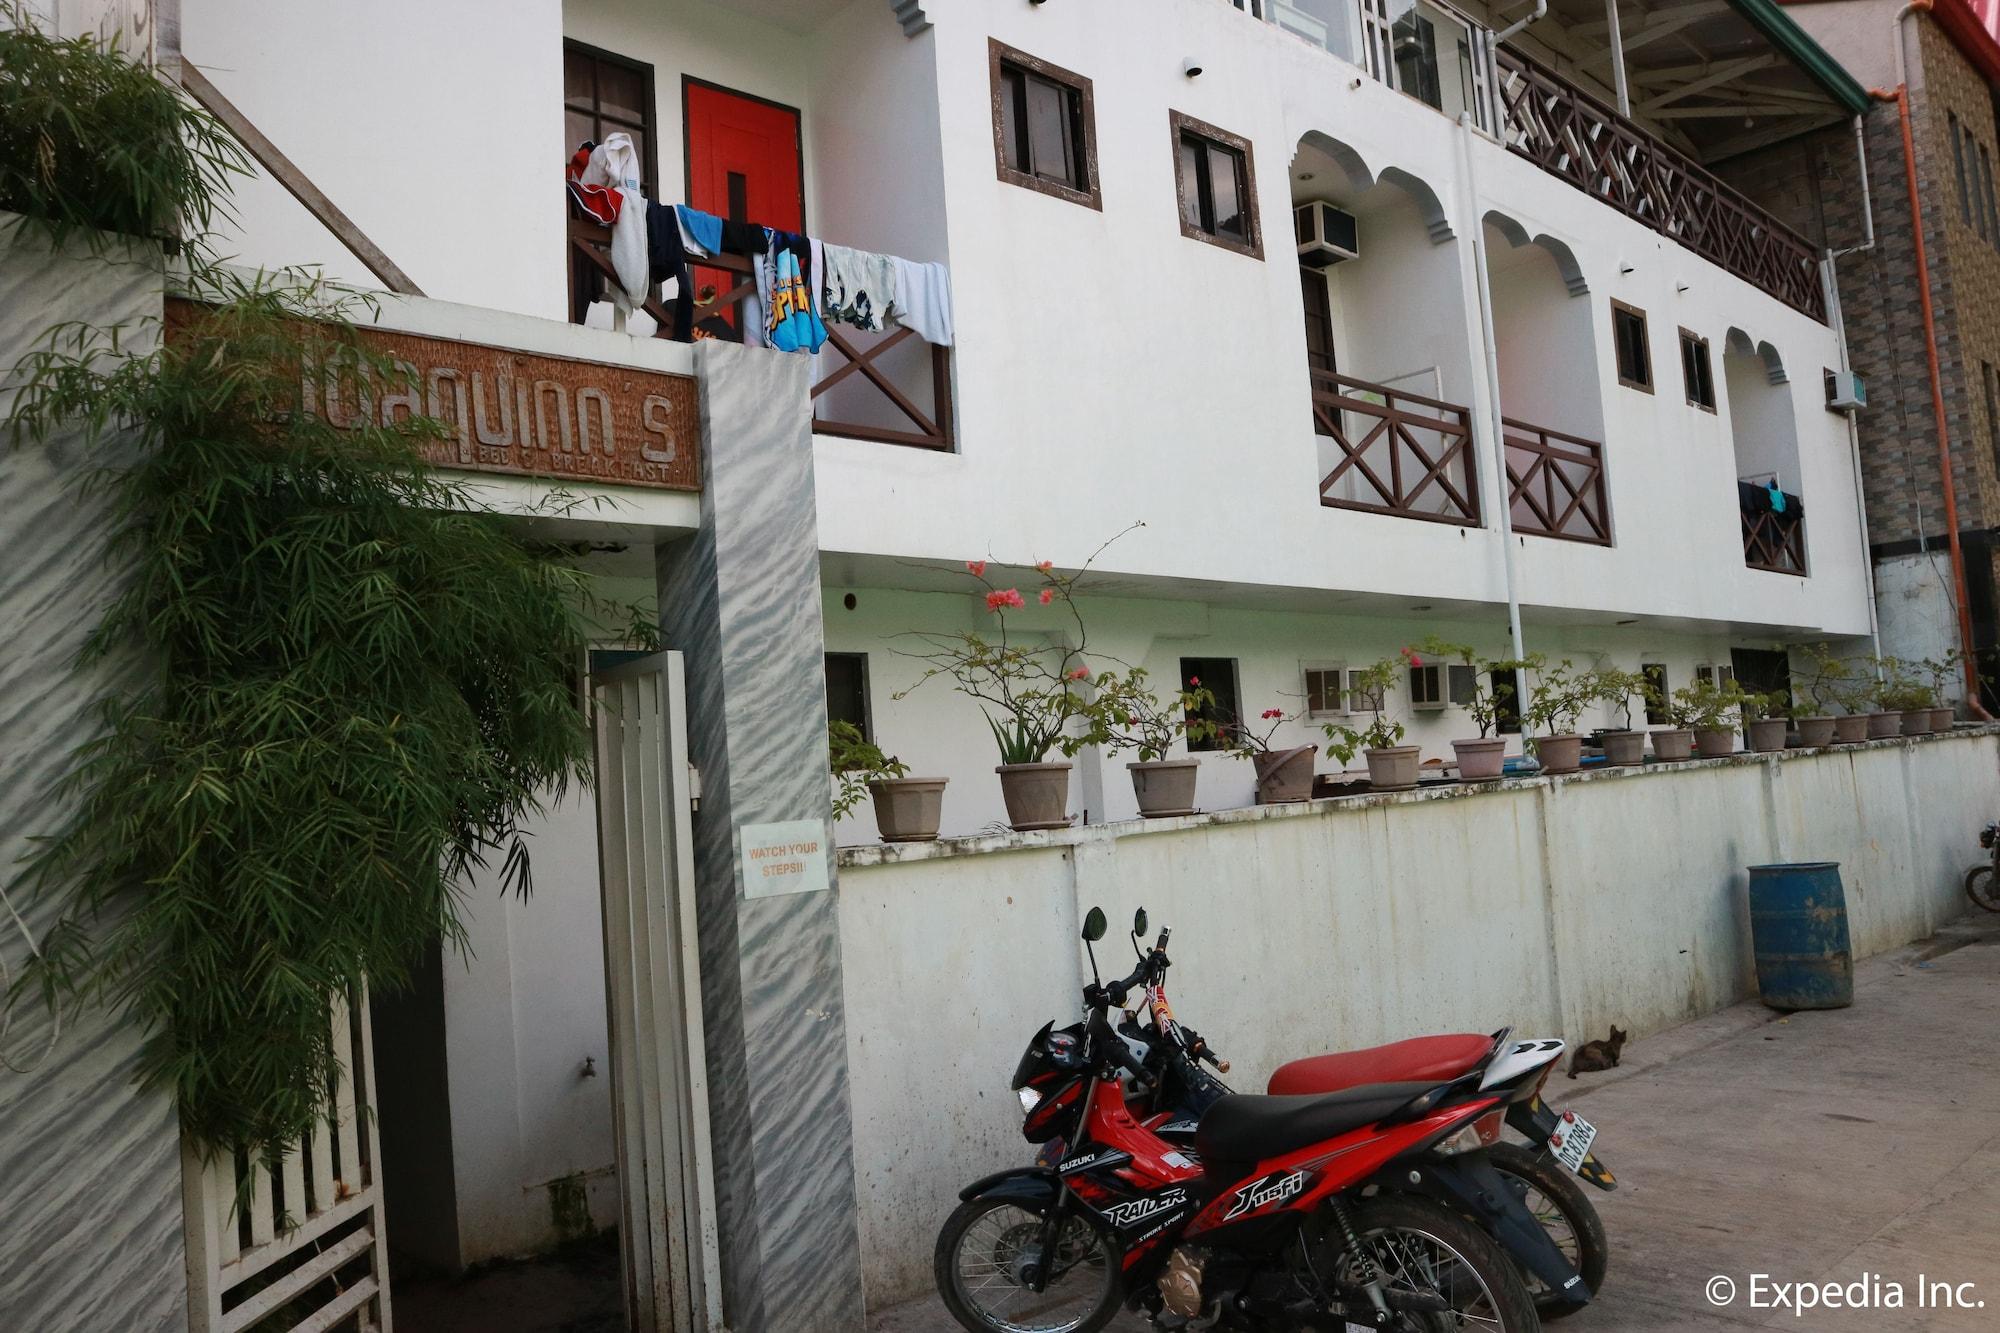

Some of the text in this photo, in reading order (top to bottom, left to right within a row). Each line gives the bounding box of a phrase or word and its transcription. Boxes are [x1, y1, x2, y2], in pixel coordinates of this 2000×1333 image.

[552, 452, 670, 482] BREAKFAST
[749, 841, 819, 860] WATCH YOUR
[1059, 1153, 1095, 1172] SUZUKI
[1101, 1188, 1187, 1227] RAIDER
